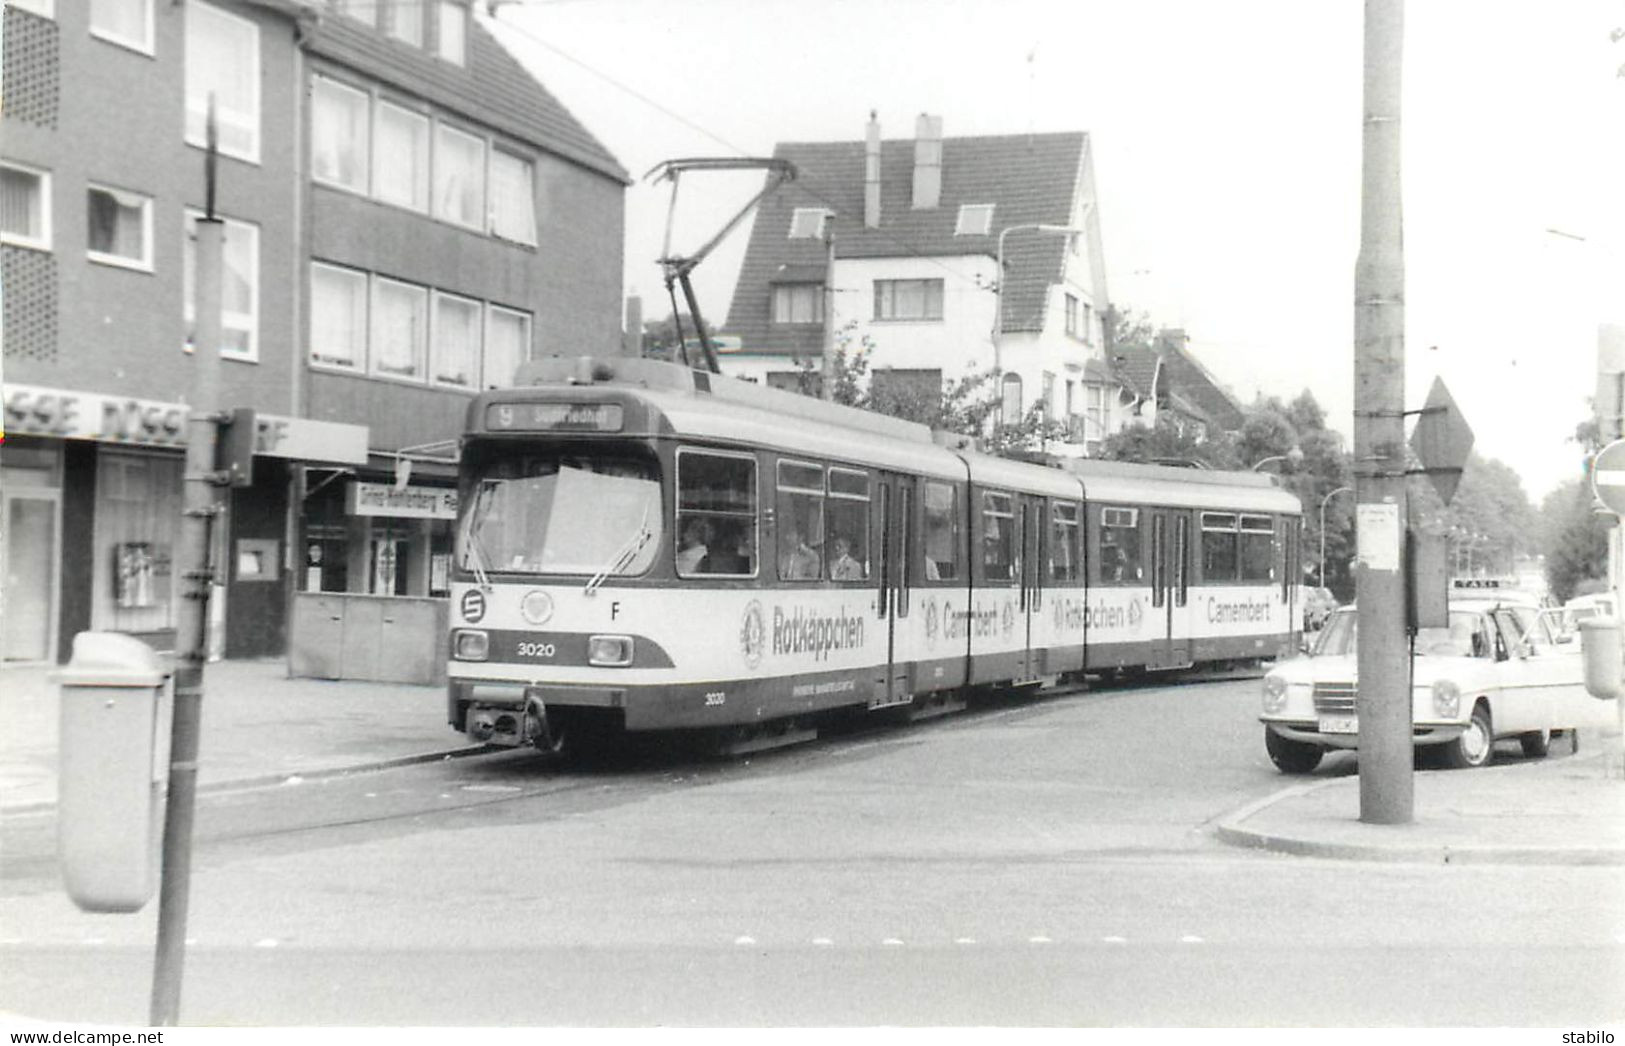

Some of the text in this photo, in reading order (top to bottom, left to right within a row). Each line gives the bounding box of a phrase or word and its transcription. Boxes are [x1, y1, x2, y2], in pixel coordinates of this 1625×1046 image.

[1456, 580, 1496, 588] TAXI
[611, 602, 620, 621] F
[1207, 596, 1270, 624] Camembert
[772, 604, 864, 661] Rotkäppchen
[517, 642, 555, 657] 3020
